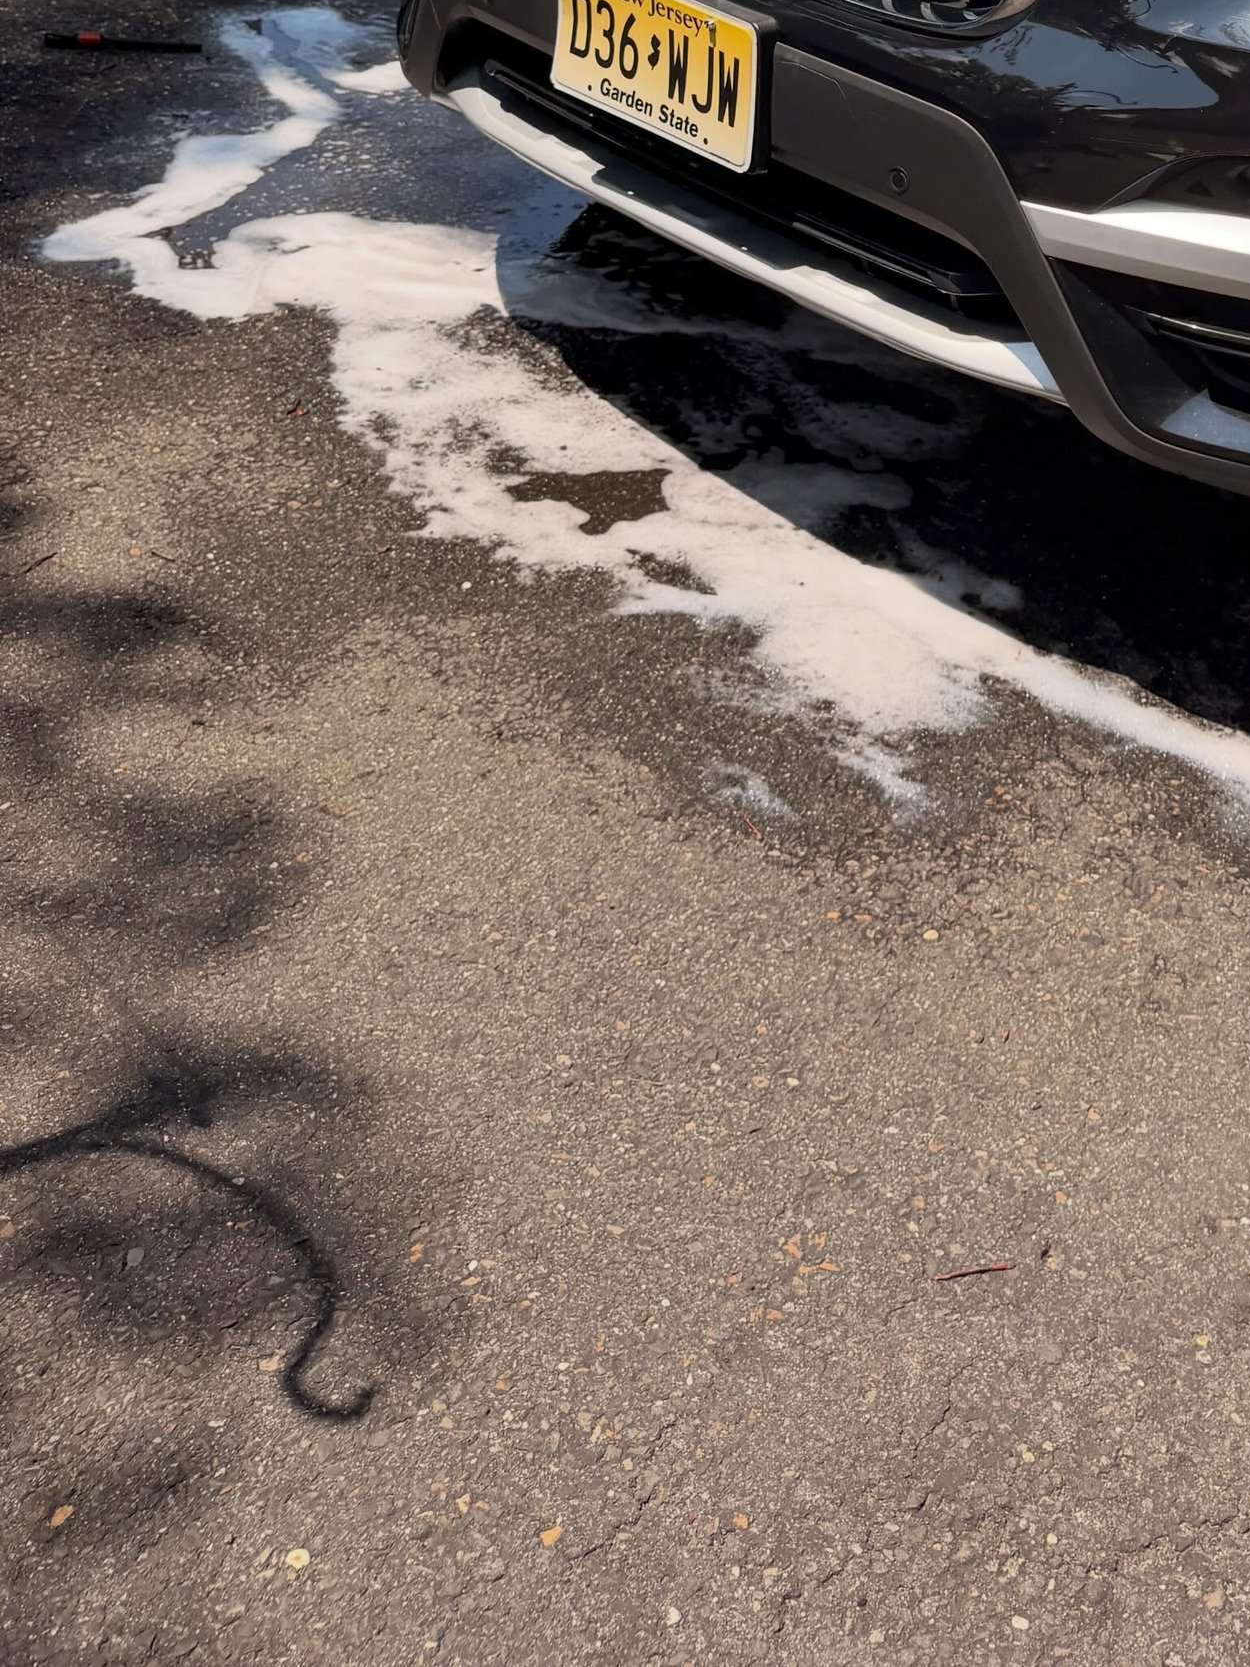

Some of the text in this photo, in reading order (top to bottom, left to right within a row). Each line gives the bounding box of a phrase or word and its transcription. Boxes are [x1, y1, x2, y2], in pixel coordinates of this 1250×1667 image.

[600, 78, 699, 138] Garden State
[667, 28, 740, 128] WJW
